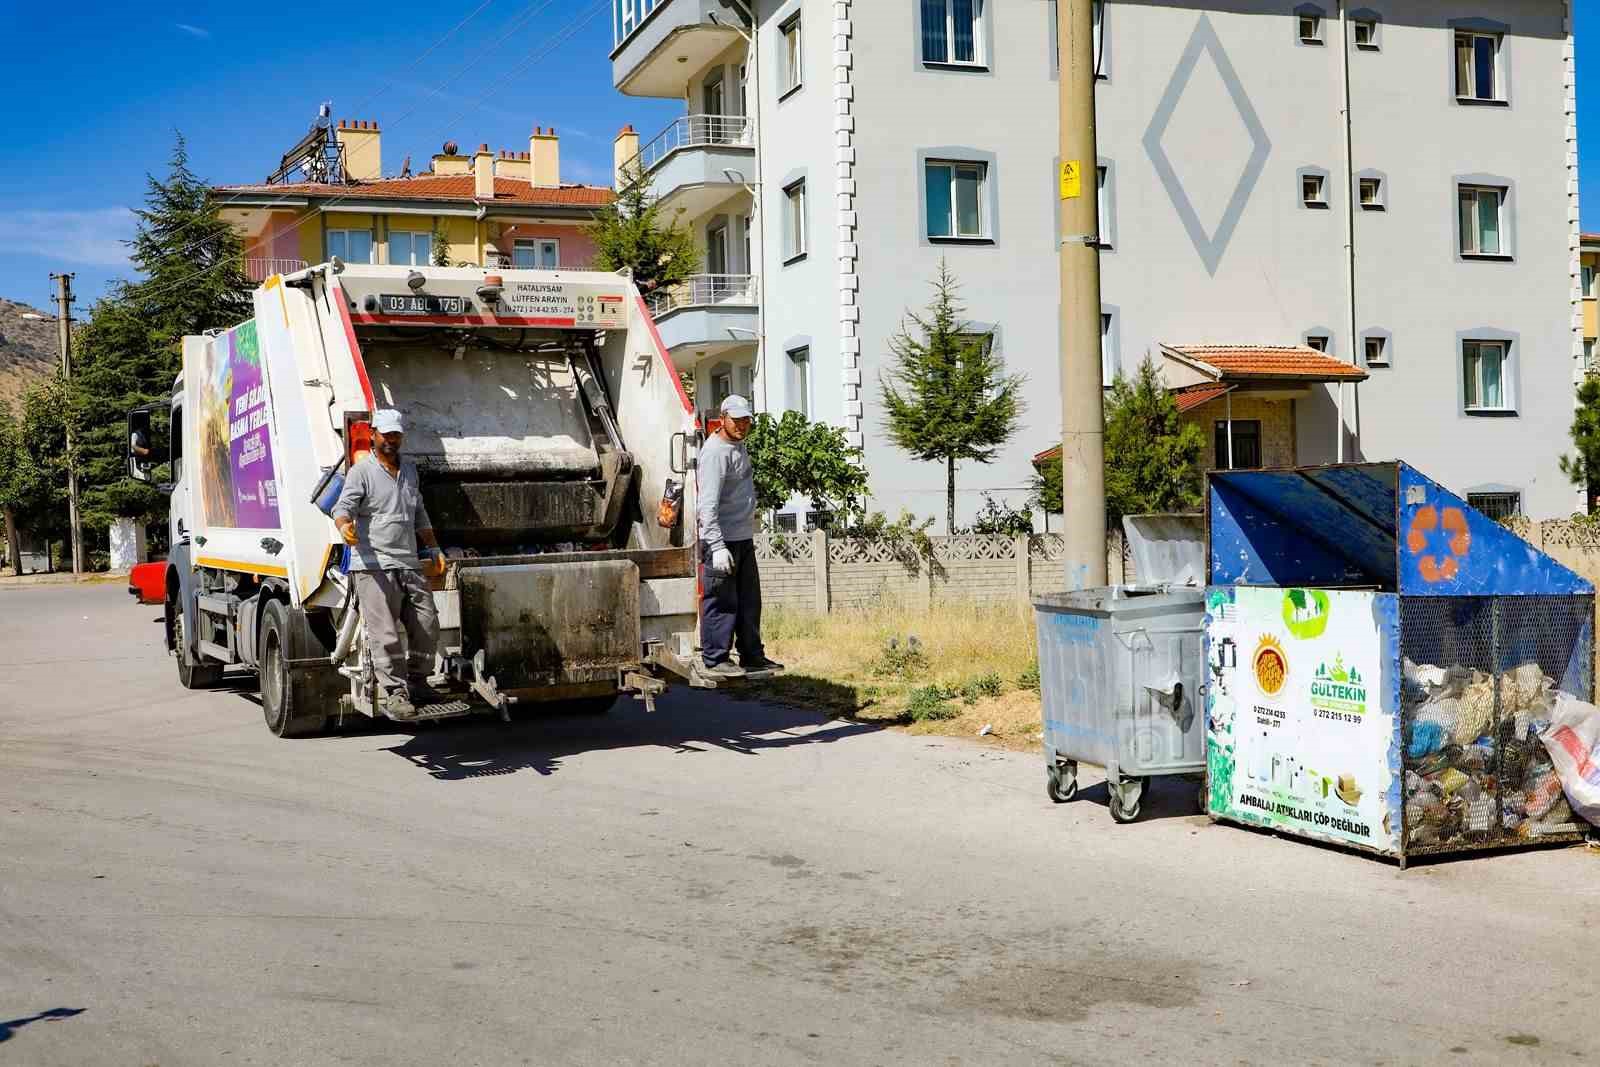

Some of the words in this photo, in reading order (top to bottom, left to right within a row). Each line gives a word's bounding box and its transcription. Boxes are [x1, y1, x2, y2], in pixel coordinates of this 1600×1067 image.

[390, 296, 405, 310] 03
[438, 298, 458, 312] 175
[541, 295, 568, 304] ARAYIN
[1311, 682, 1366, 702] GÜLTEKİN
[1319, 709, 1330, 719] 272
[1331, 711, 1342, 721] 215
[1344, 713, 1352, 723] 12
[1239, 794, 1275, 814] AMBALAJ
[1276, 803, 1313, 823] ATIKLARI
[1313, 811, 1330, 826] ÇÖP
[1331, 818, 1370, 838] DEĞİLDİR
